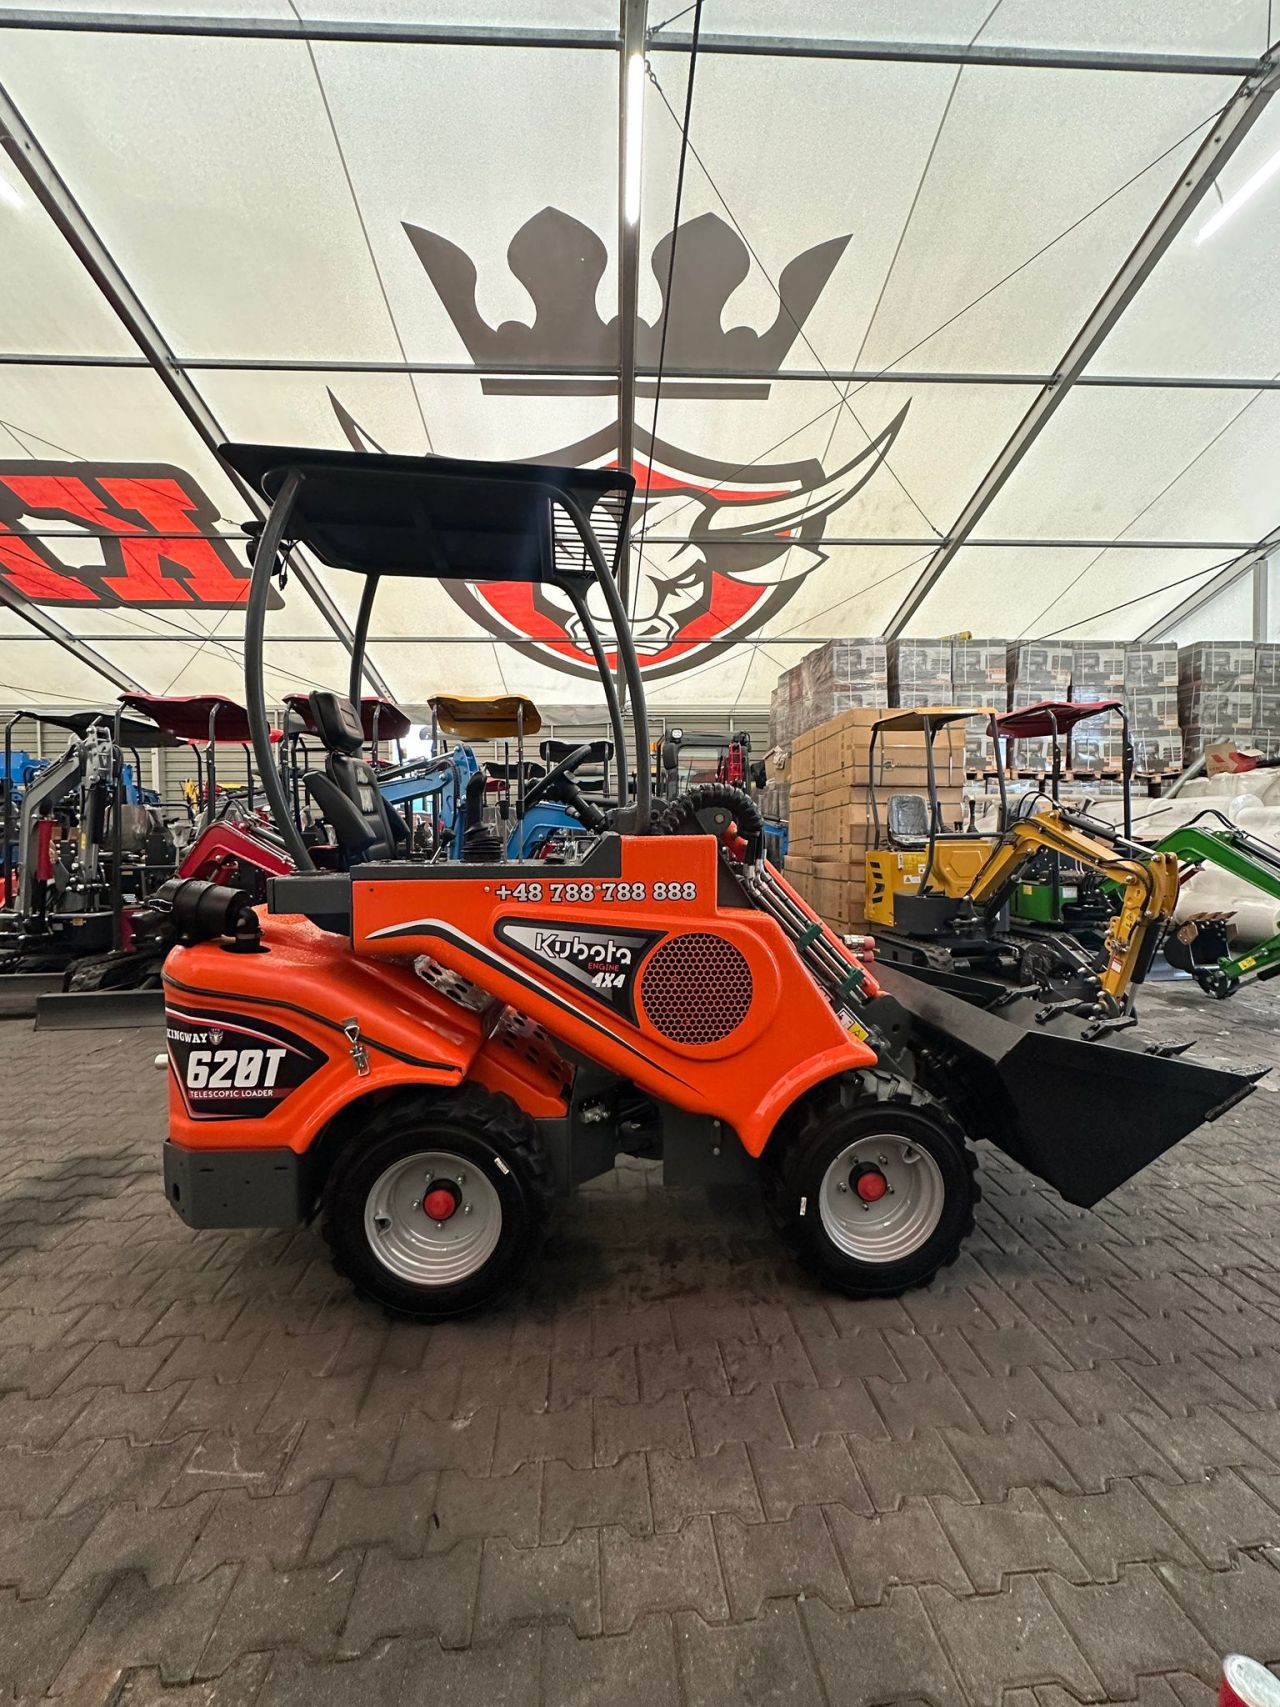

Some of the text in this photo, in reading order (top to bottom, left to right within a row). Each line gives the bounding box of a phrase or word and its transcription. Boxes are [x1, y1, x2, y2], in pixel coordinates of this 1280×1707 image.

[495, 882, 697, 902] +48 788 788 888
[534, 932, 632, 965] Kubota
[587, 962, 620, 972] ENGINE
[166, 1028, 208, 1043] KINGWAY
[187, 1049, 286, 1088] 620T
[190, 1089, 274, 1099] TELESCOPIC LOADER
